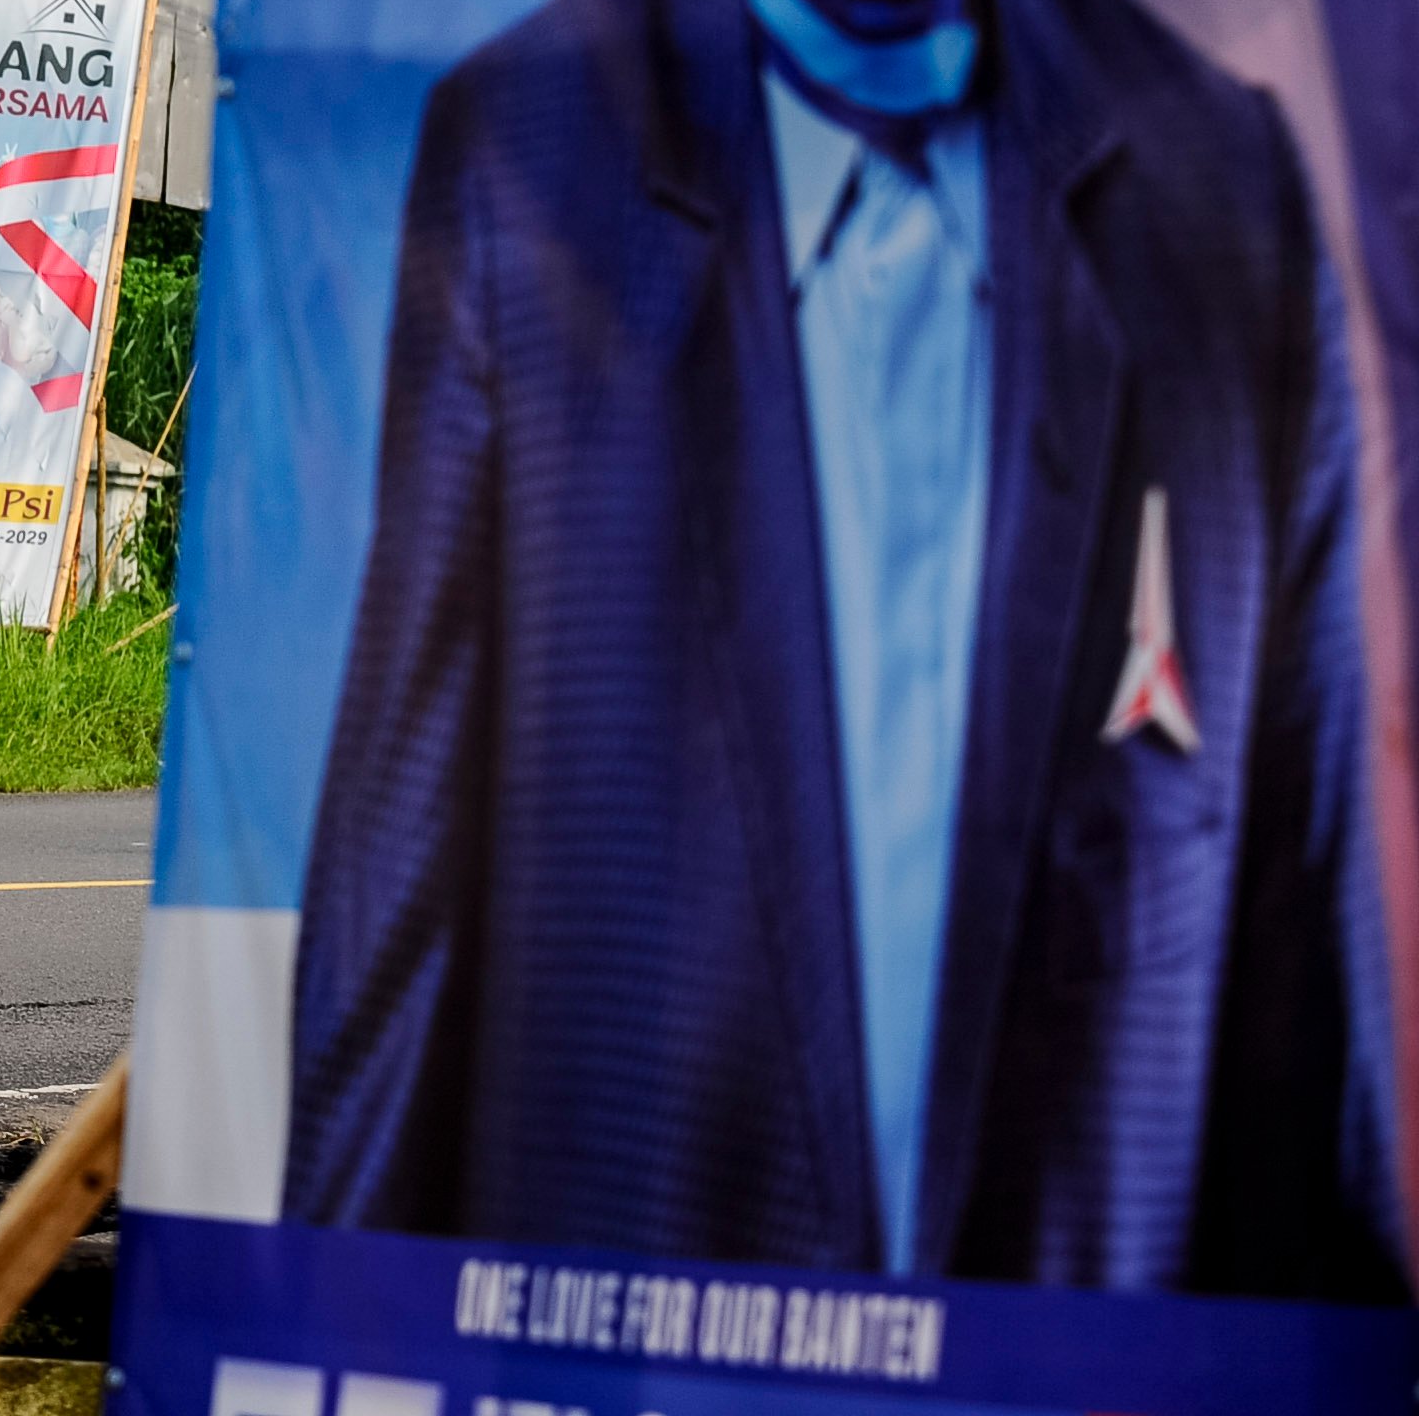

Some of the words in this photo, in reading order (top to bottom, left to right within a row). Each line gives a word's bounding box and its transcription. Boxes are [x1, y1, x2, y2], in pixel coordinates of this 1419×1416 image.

[455, 1257, 528, 1339] ONE
[528, 1264, 623, 1352] LOVE
[619, 1273, 698, 1358] FOR
[697, 1279, 779, 1367] OUR
[779, 1286, 946, 1383] BANTEN
